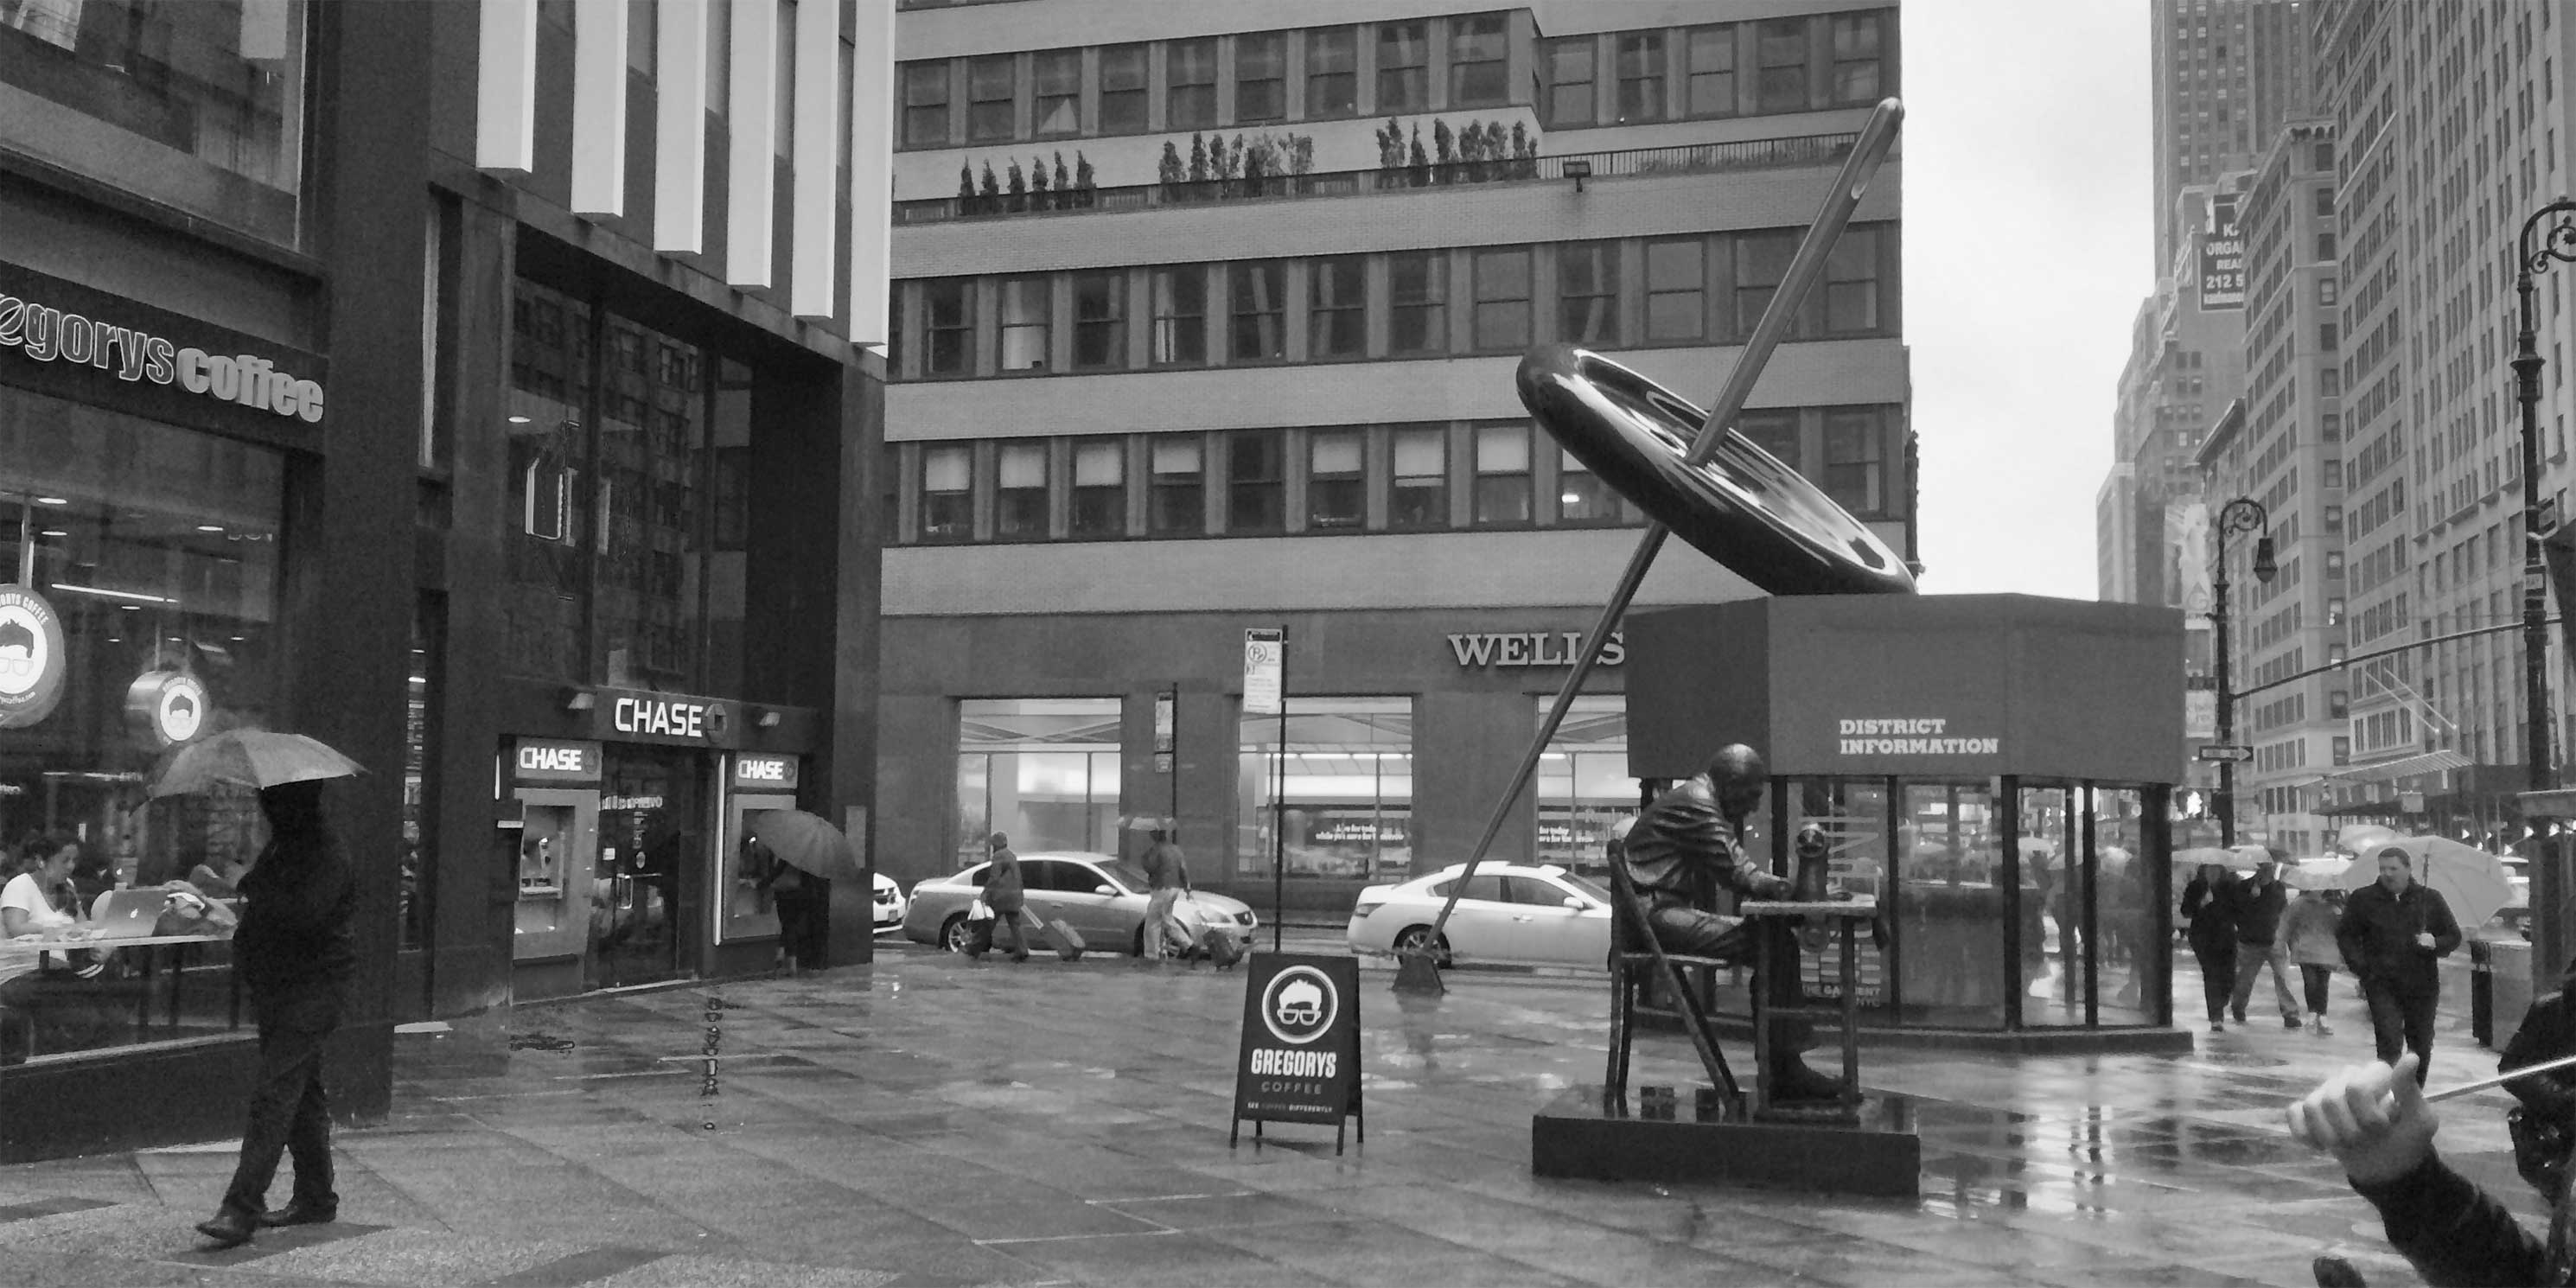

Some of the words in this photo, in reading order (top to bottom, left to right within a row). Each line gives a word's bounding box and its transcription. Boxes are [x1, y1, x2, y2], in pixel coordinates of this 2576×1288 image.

[2206, 241, 2244, 256] ORGA
[2206, 274, 2232, 289] 212
[0, 293, 174, 385] egorys
[176, 348, 324, 423] coffee
[22, 596, 50, 625] COFFEE
[1447, 632, 1626, 666] WELLS
[615, 698, 703, 737] CHASE
[1840, 718, 1947, 735] DISTRICT
[1840, 737, 1999, 755] INFORMATION
[520, 747, 583, 771] CHASE
[737, 760, 784, 781] CHASE
[1251, 1049, 1337, 1078] GREGORYS
[1261, 1081, 1322, 1094] COFFEE
